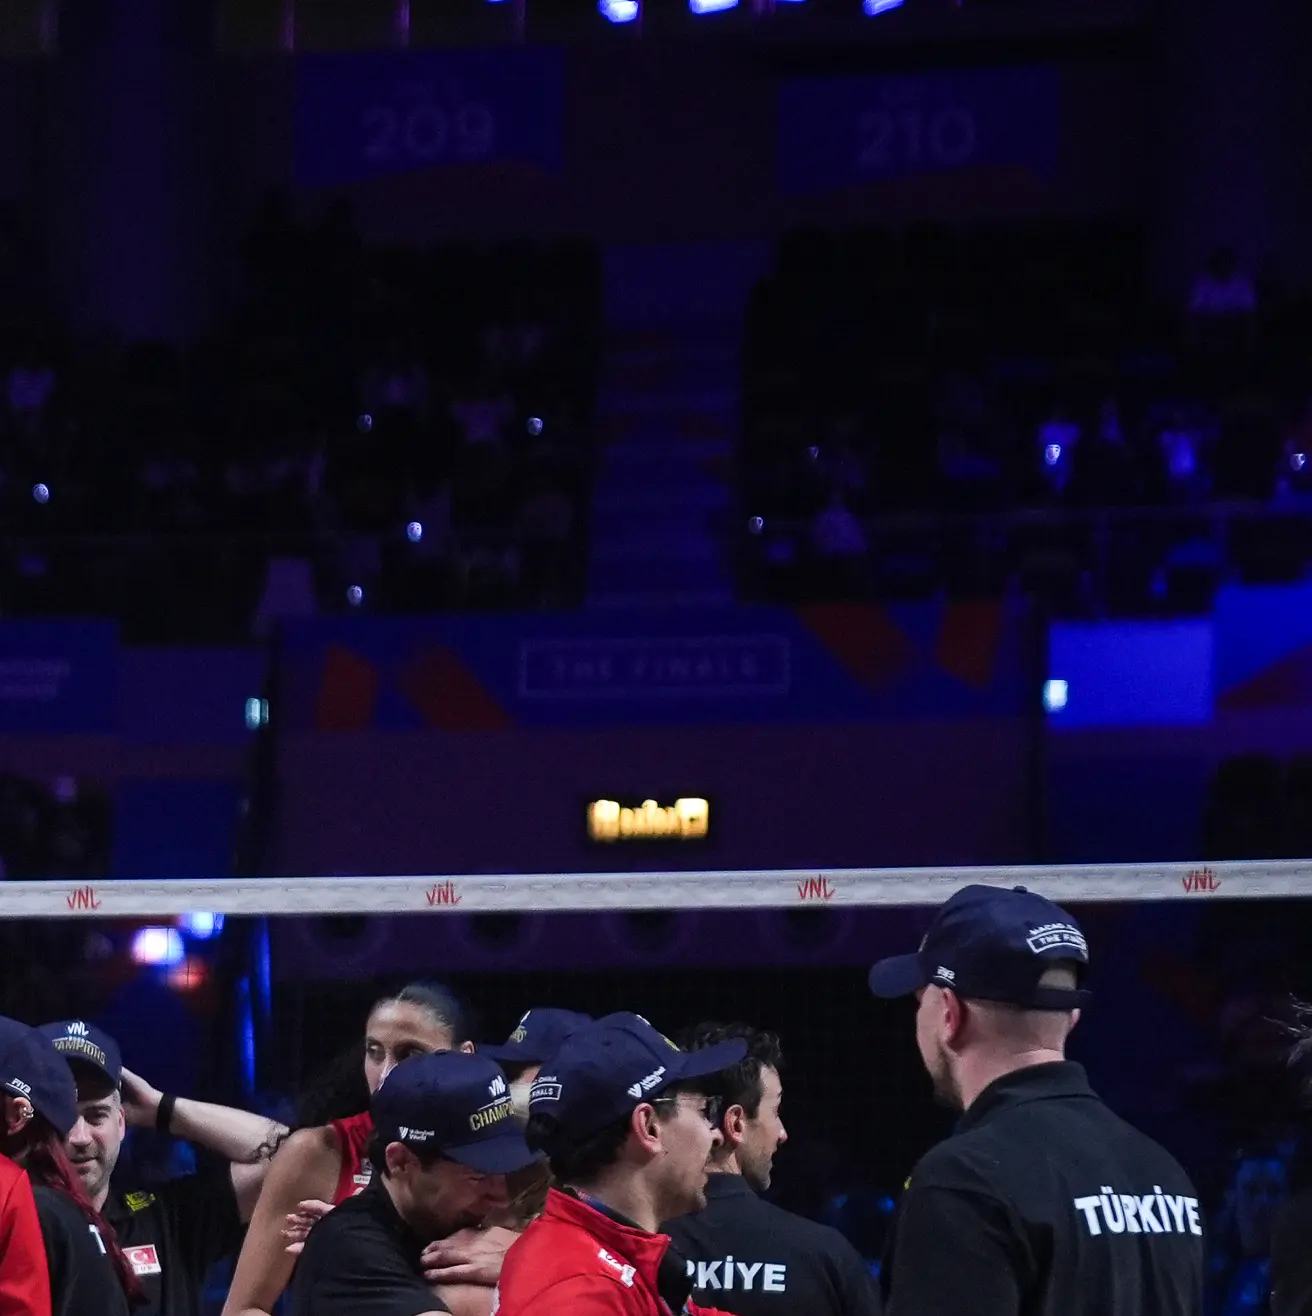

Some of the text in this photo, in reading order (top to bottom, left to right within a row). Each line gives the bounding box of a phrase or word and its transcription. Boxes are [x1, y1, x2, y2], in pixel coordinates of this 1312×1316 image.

[360, 104, 495, 163] 209
[856, 107, 978, 168] 210
[66, 885, 102, 910] VNL
[797, 874, 836, 901] VNL
[1074, 1186, 1204, 1237] TÜRKİYE
